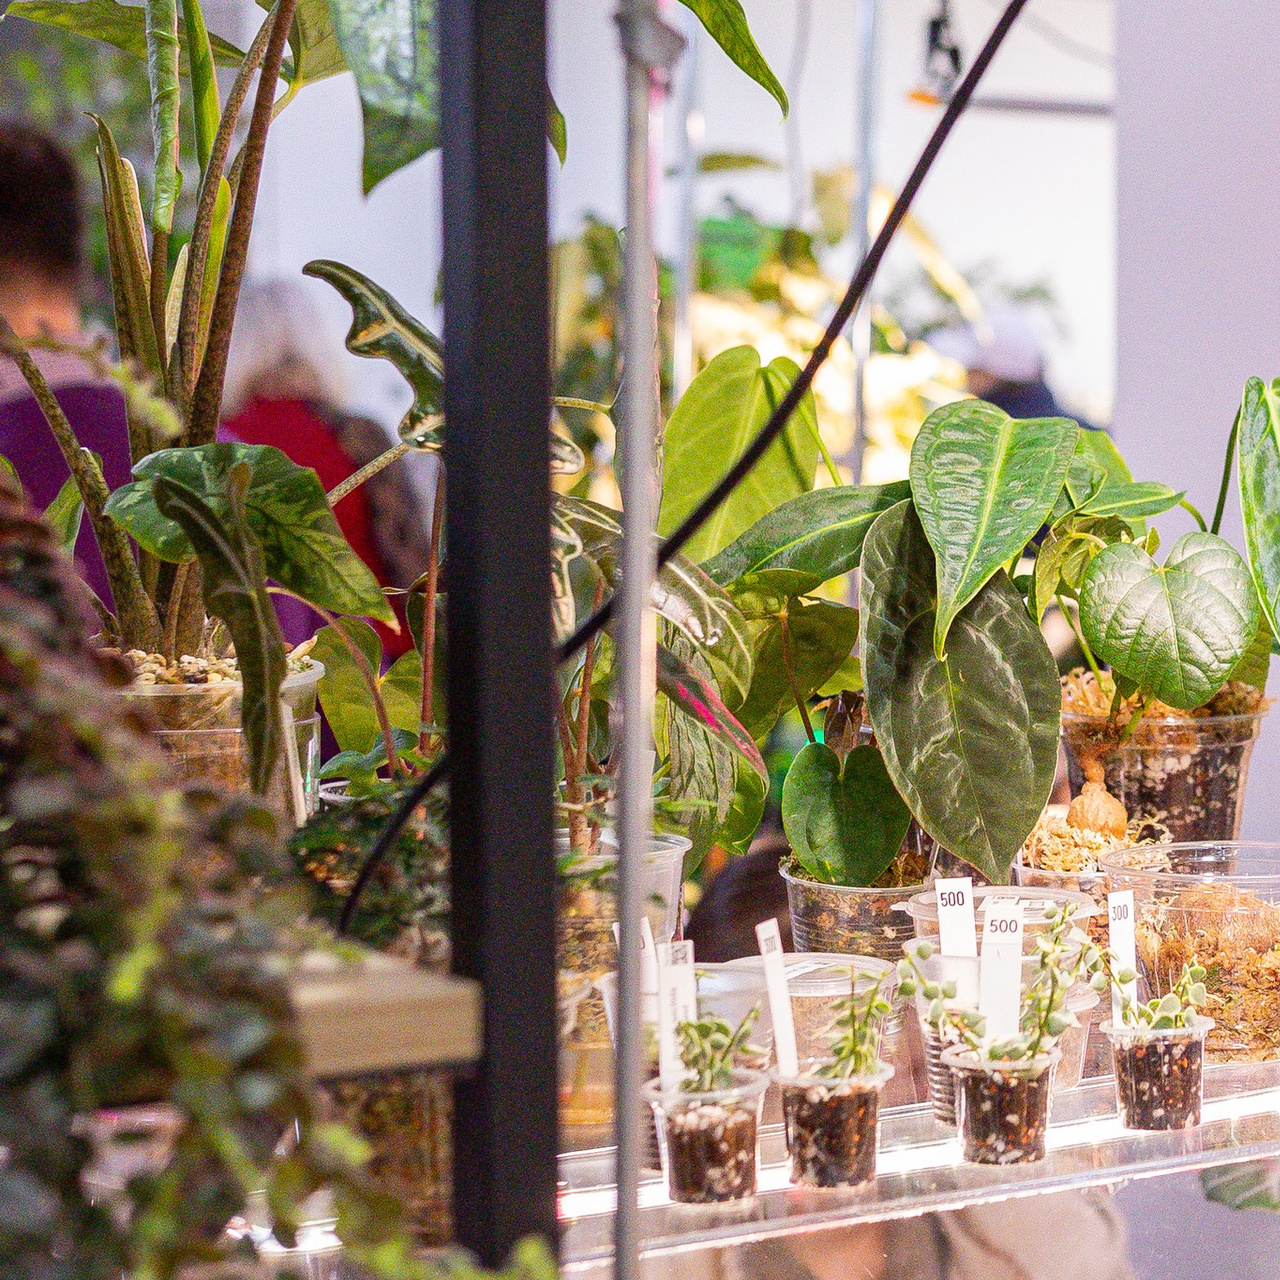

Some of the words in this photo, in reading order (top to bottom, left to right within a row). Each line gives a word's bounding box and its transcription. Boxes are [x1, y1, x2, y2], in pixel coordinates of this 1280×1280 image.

[940, 891, 965, 907] 500
[1112, 904, 1128, 921] 300
[989, 919, 1018, 933] 500
